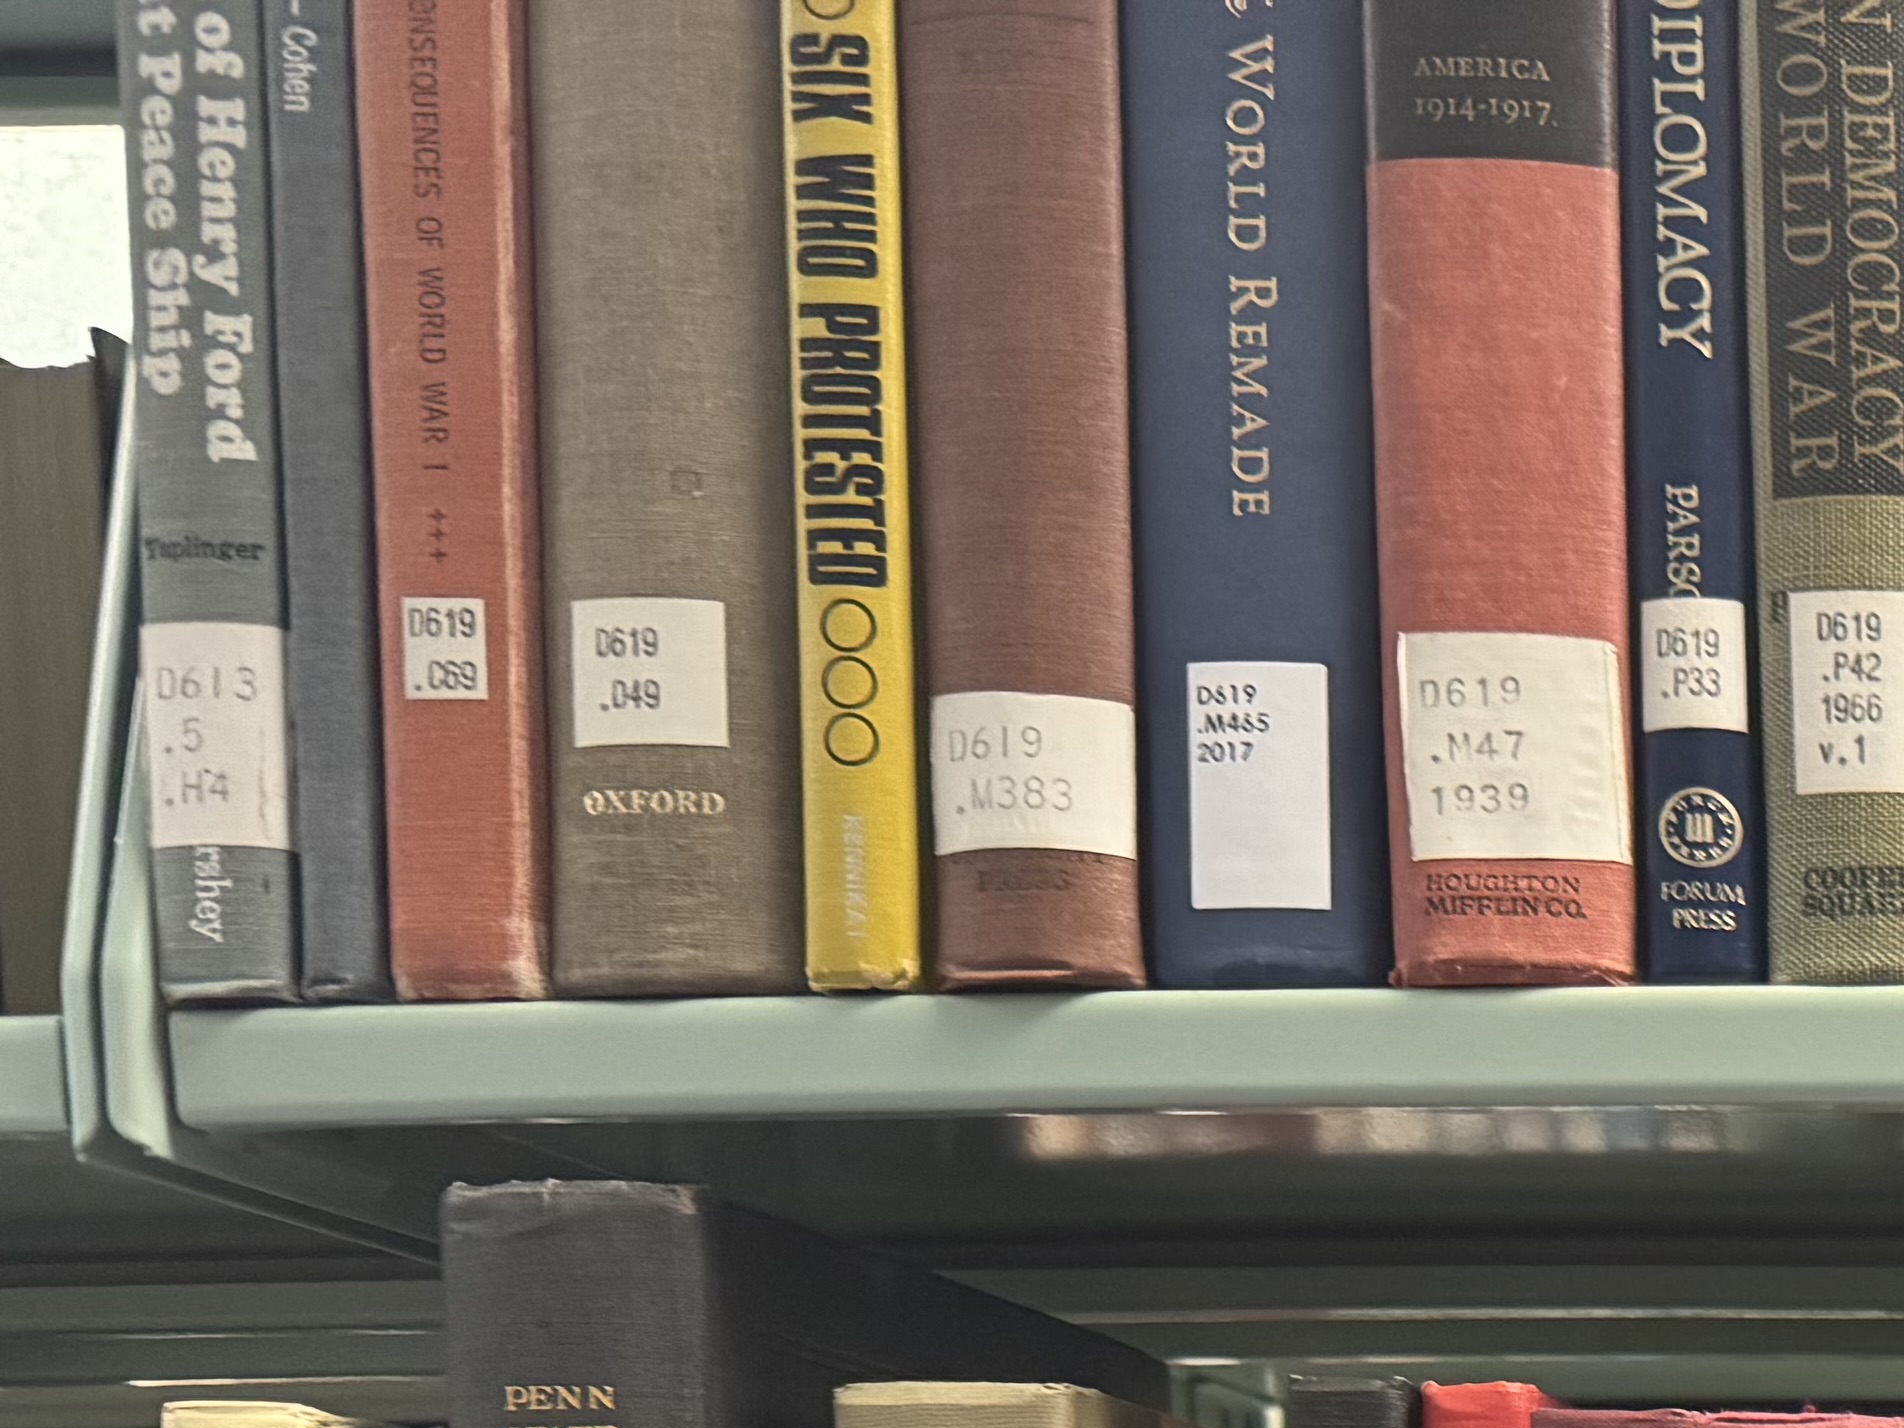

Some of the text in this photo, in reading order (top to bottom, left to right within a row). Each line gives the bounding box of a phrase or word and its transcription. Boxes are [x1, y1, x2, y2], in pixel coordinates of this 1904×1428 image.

[281, 28, 319, 113] Cohen
[1414, 56, 1551, 82] AMERICA
[137, 52, 193, 396] Peace Ship
[194, 15, 257, 462] of Henry Ford
[416, 217, 450, 472] OF WORLD WAR I
[789, 33, 887, 588] SIX WHO PROTESTED
[1225, 35, 1278, 517] WORLD REMADE
[1841, 61, 1904, 475] DEMOCRACY
[584, 789, 725, 815] OXFORD
[504, 1385, 614, 1411] PENN
